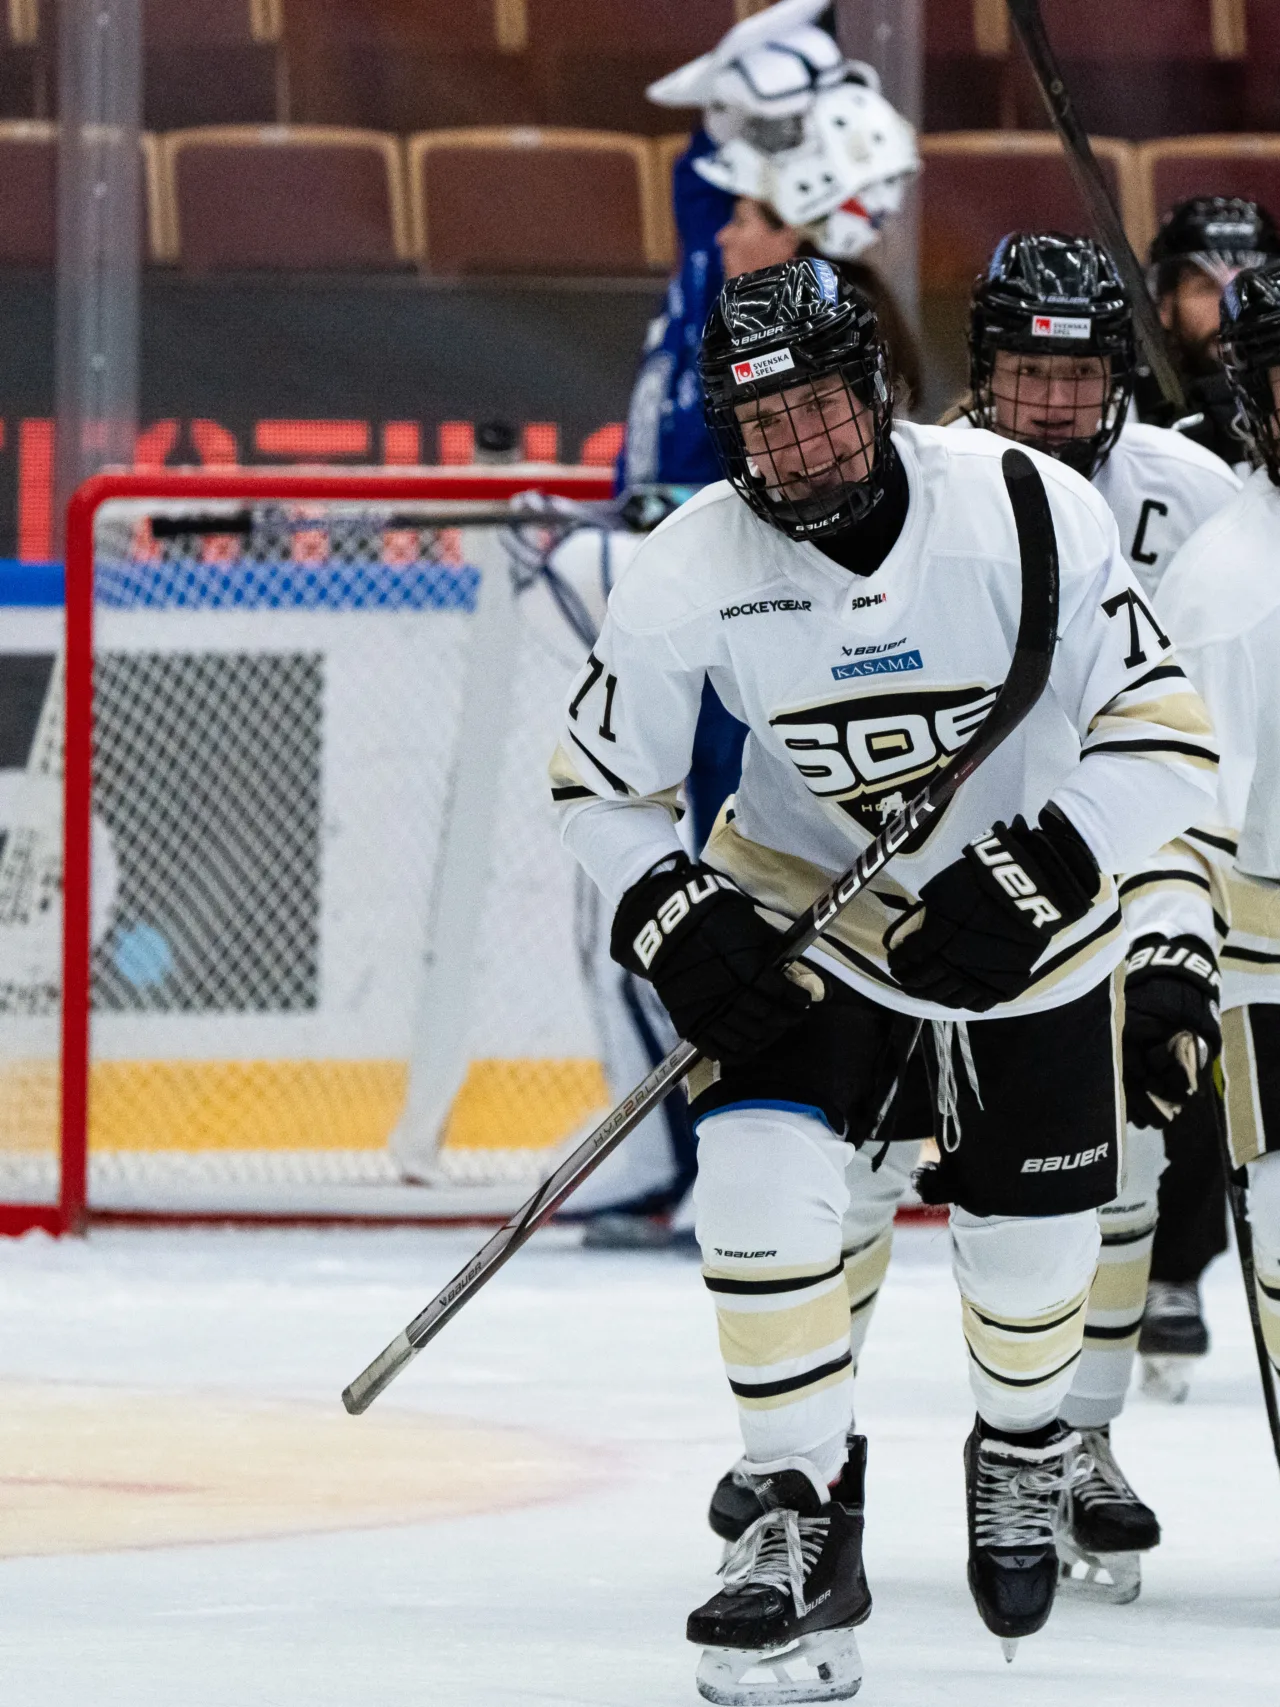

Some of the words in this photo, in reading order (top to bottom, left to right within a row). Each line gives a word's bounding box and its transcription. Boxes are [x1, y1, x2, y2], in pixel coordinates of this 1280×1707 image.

[741, 325, 785, 345] BAUER
[752, 353, 790, 370] SVENSKA
[755, 366, 776, 377] SPEL
[795, 512, 840, 531] BAUER
[1131, 499, 1168, 565] C
[719, 599, 812, 621] HOCKEYGEAR
[1101, 586, 1172, 669] 71
[853, 637, 908, 656] BAUER
[834, 655, 920, 680] KASAMA
[568, 651, 618, 743] 71
[813, 784, 937, 932] BAUER
[633, 874, 746, 970] BAU
[1020, 1142, 1109, 1173] BAUER
[724, 1250, 778, 1259] BAUER
[805, 1589, 831, 1615] AUER
